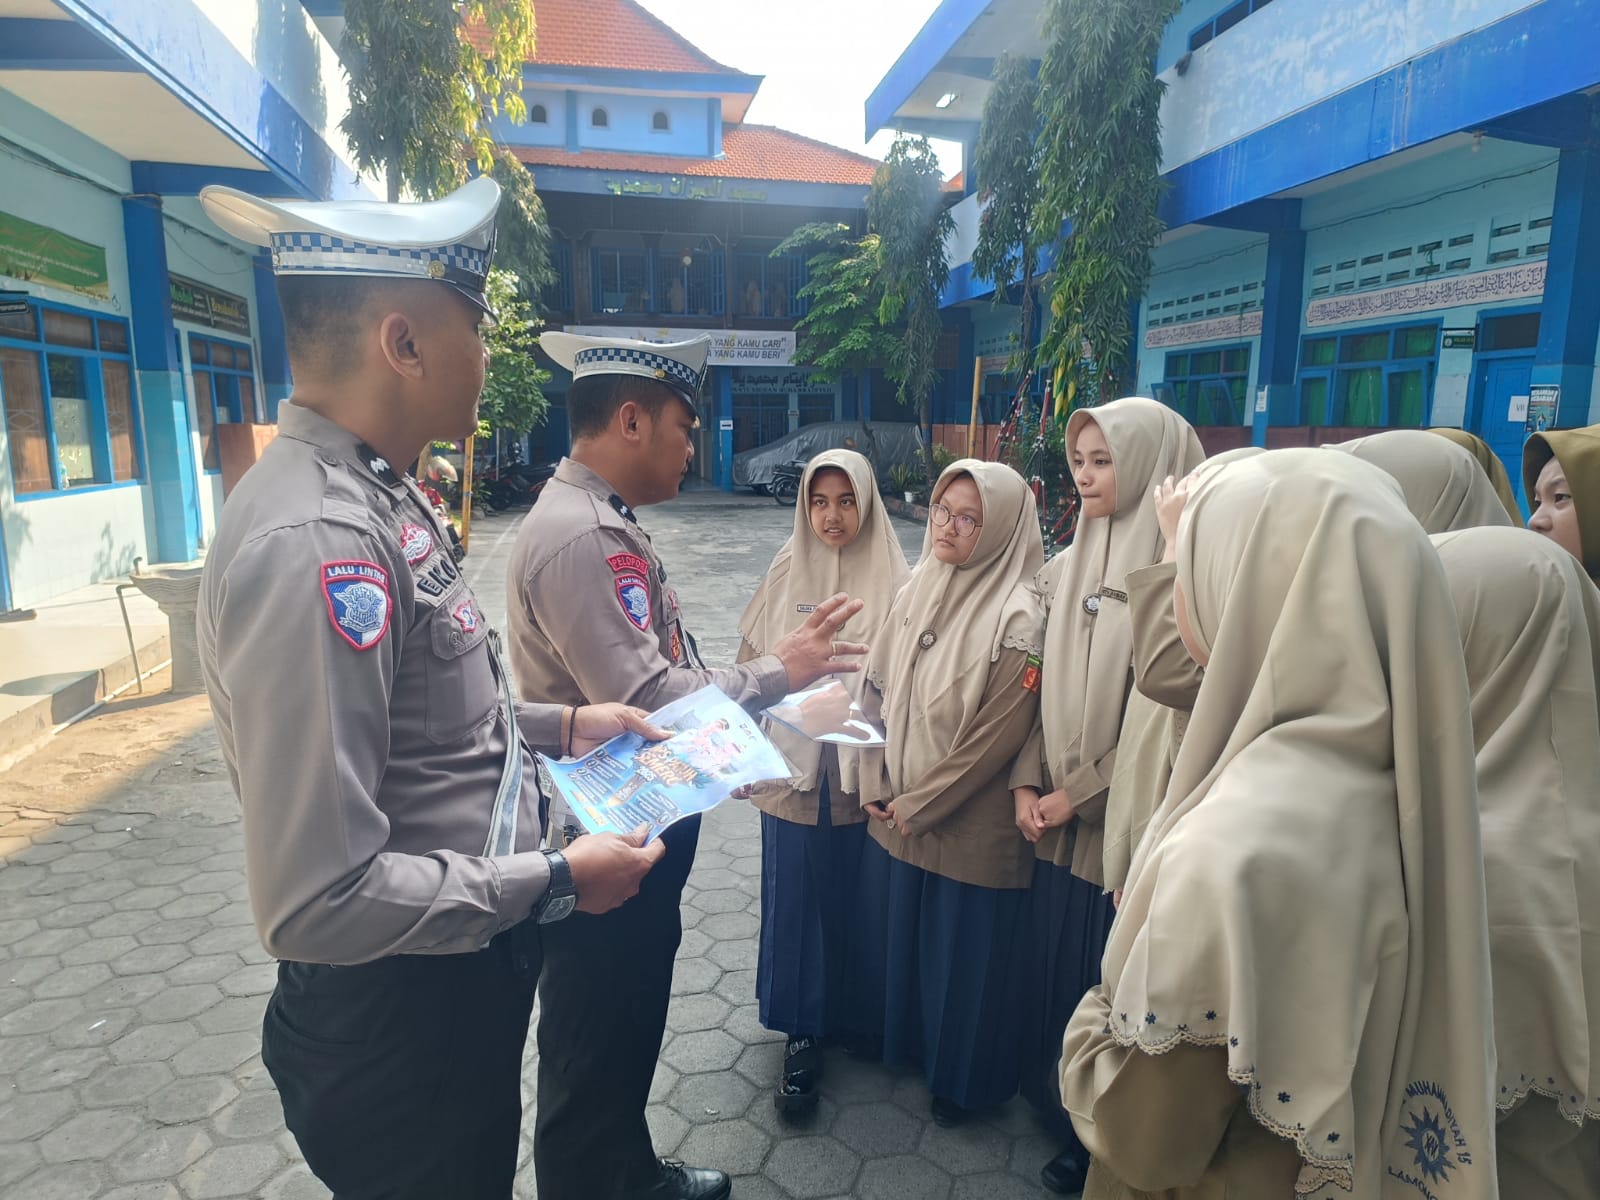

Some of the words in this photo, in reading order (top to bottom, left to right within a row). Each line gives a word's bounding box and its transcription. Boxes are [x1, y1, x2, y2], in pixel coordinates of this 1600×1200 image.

[713, 337, 735, 347] YANG
[737, 338, 760, 348] KAMU
[713, 349, 735, 358] YANG
[737, 349, 760, 358] KAMU
[611, 556, 646, 571] PELOPOR
[327, 565, 355, 577] LALU
[417, 559, 457, 597] EKO
